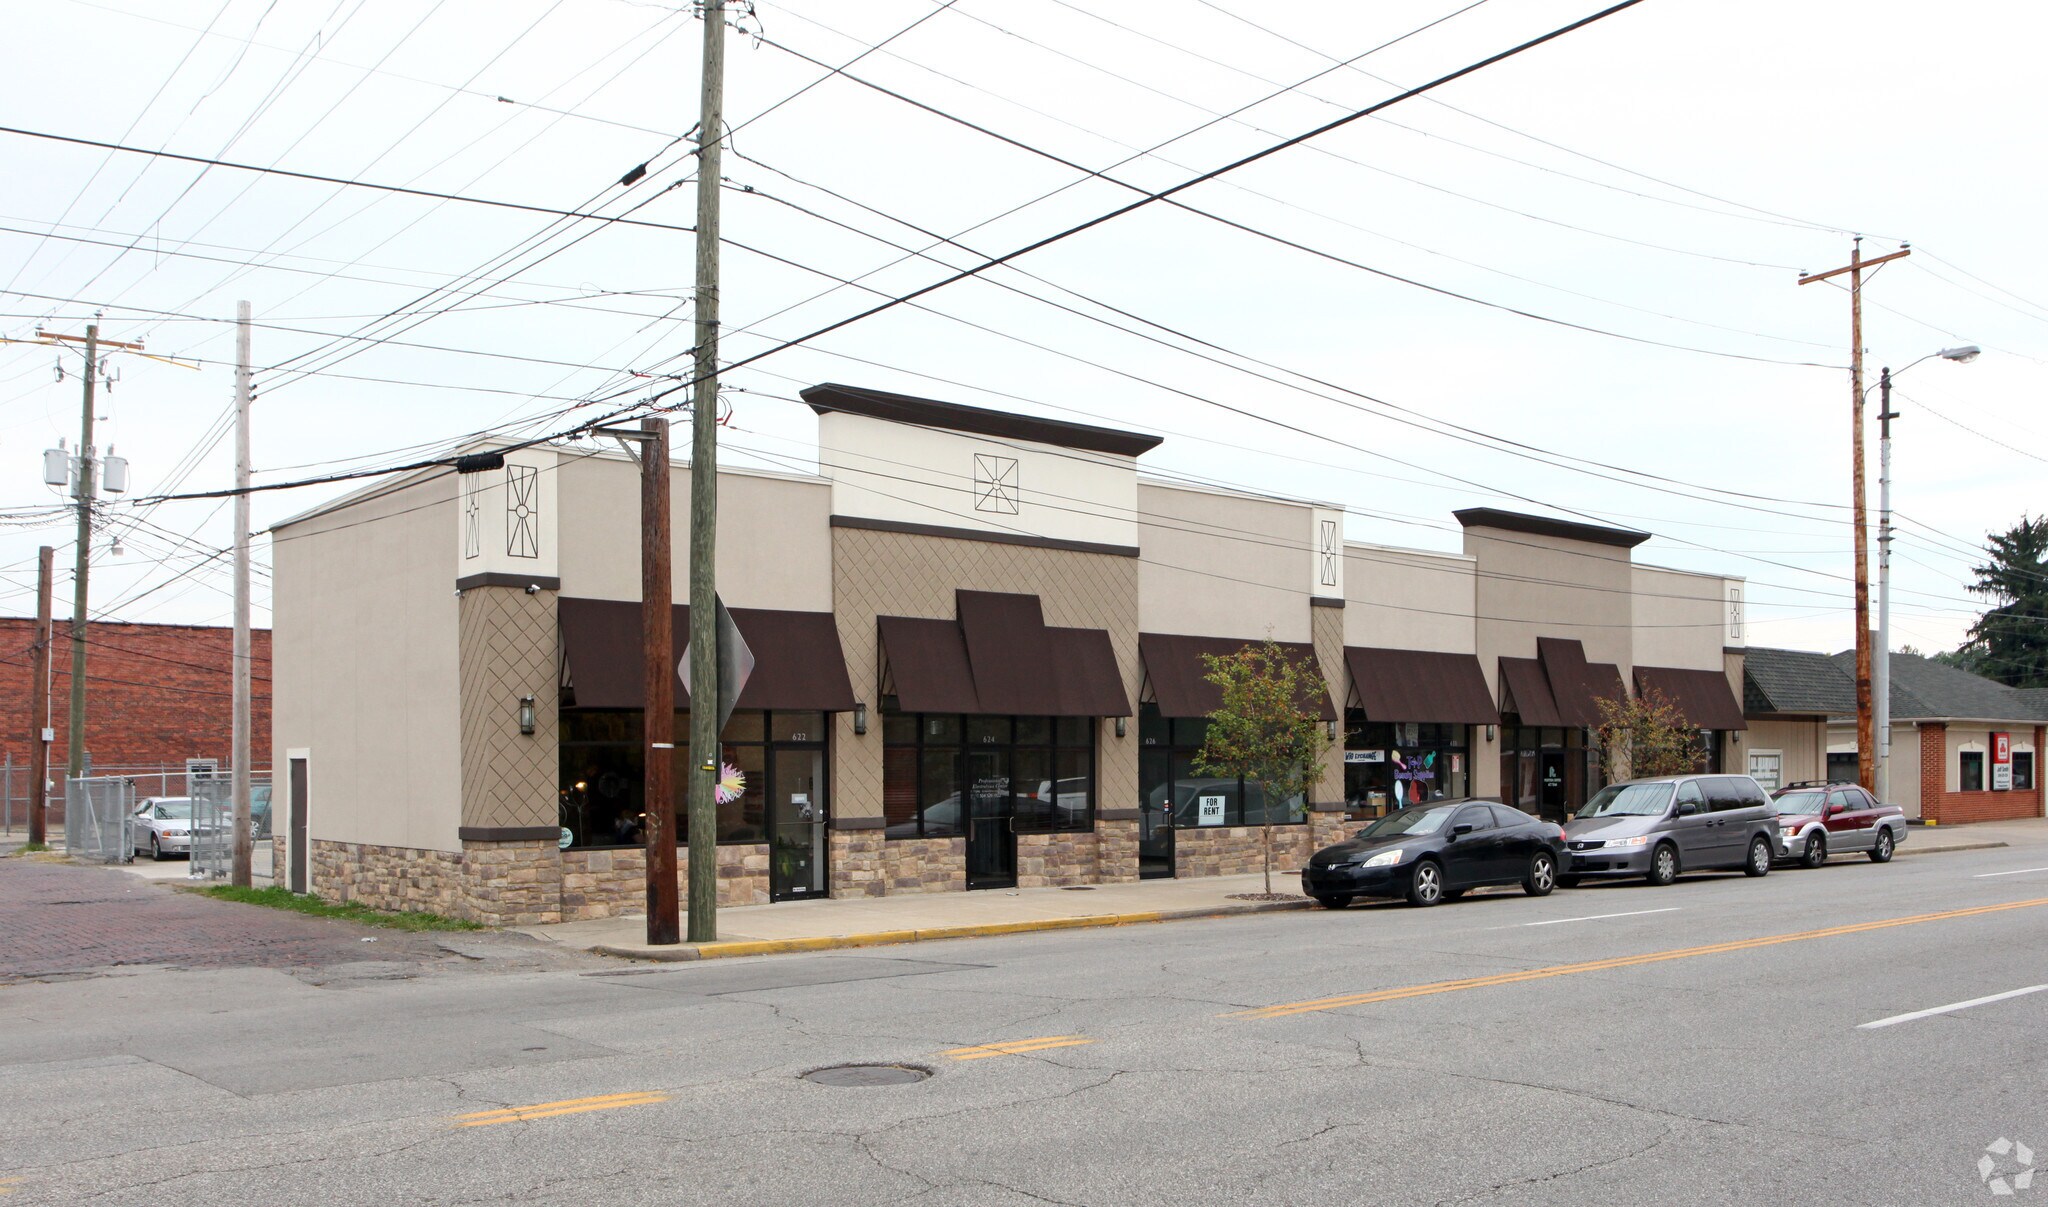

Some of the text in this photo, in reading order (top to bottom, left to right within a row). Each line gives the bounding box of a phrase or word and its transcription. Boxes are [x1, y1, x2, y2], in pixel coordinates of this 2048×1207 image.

[792, 733, 806, 741] 622
[983, 735, 995, 743] 624
[1394, 769, 1412, 780] Beauty
[1206, 797, 1218, 807] FOR
[1204, 807, 1219, 815] RENT
